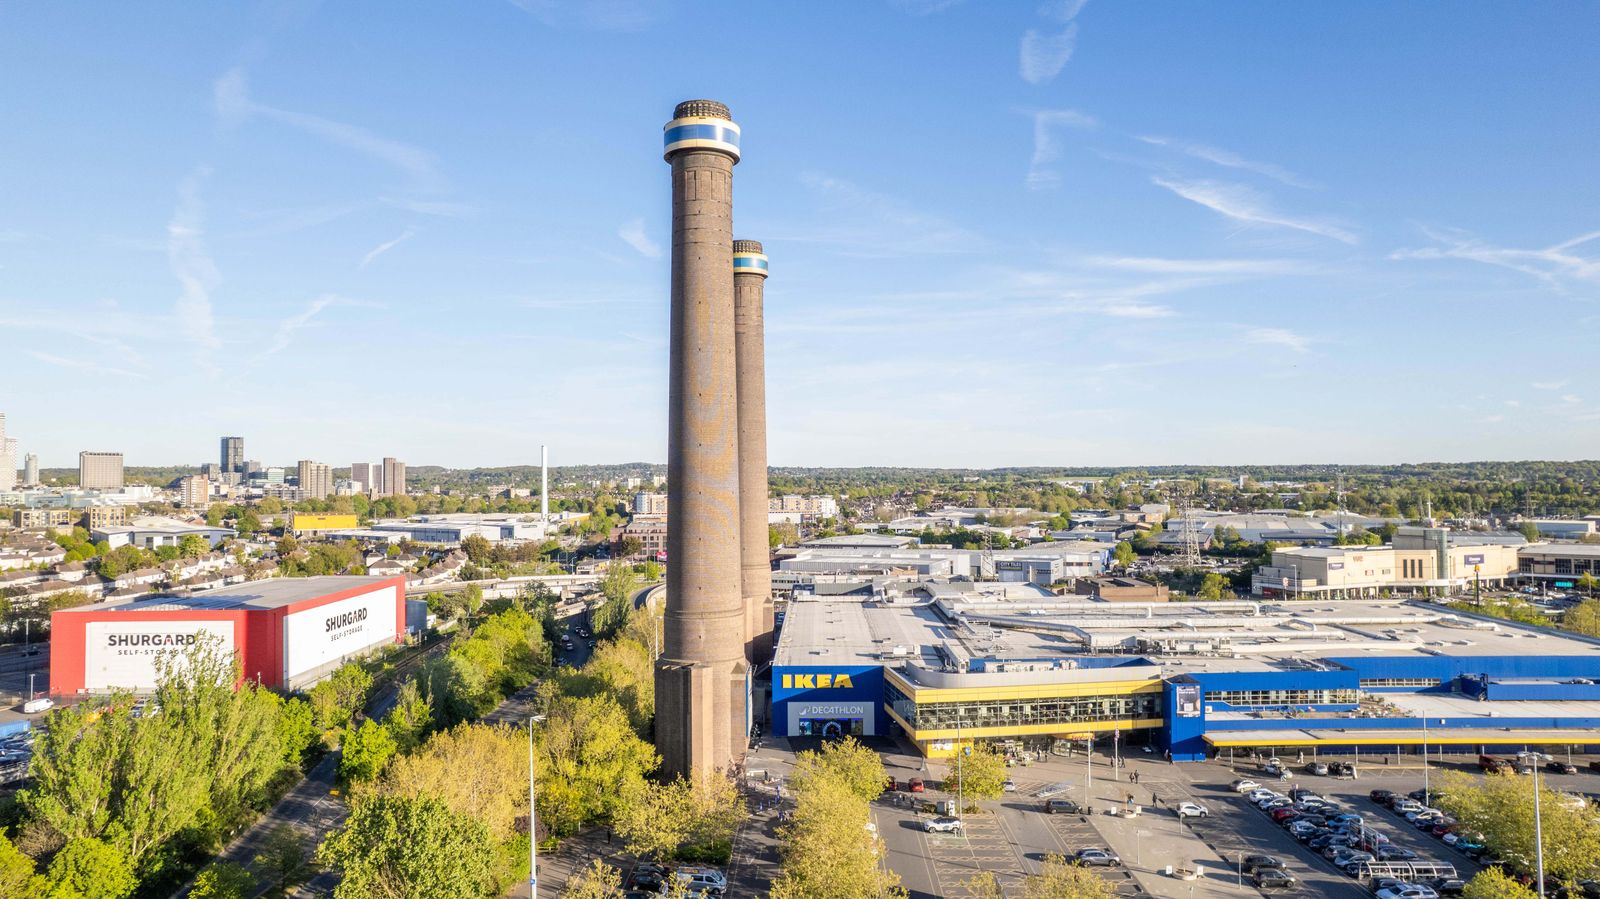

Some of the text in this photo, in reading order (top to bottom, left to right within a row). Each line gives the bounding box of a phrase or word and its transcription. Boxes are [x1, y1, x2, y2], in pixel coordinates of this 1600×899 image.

[325, 607, 368, 632] SHURGARD
[108, 634, 196, 646] SHURGARD
[330, 625, 363, 642] SELF-STORAGE
[782, 673, 854, 689] IKEA
[812, 706, 864, 715] DECATHLON
